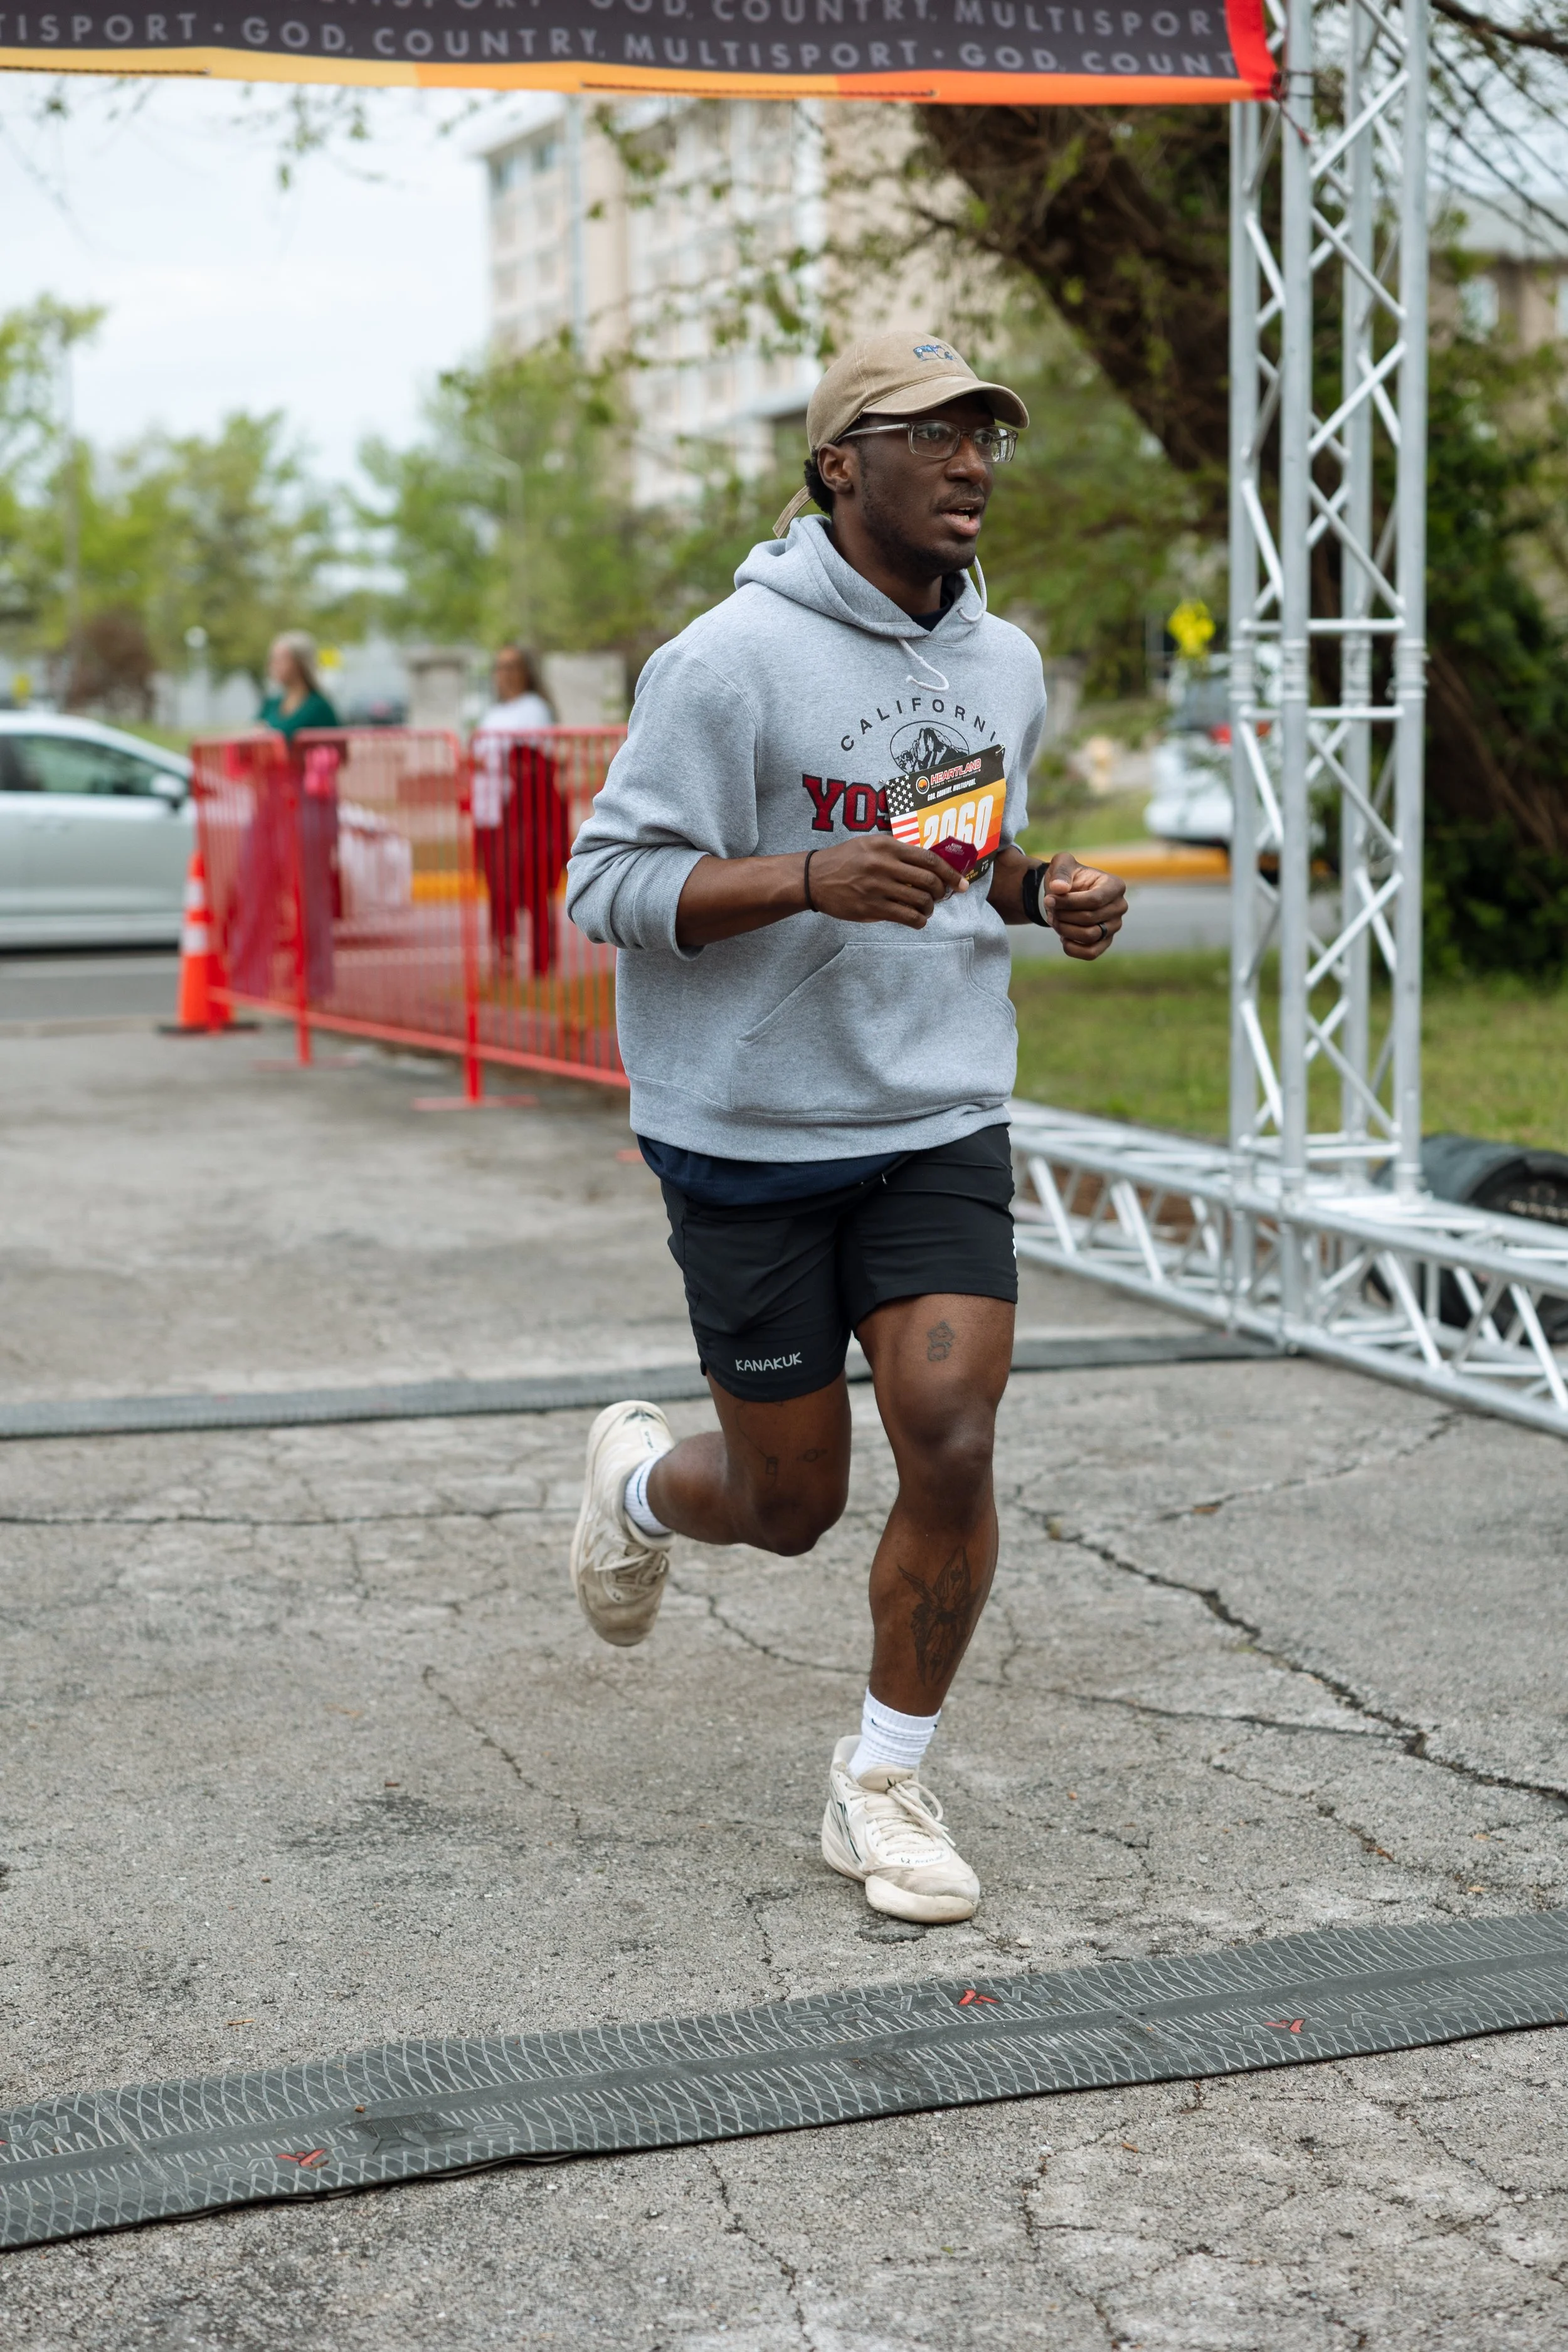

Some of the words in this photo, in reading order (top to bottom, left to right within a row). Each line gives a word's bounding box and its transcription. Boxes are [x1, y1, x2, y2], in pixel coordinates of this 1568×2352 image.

[955, 0, 1226, 38] MULTISPOR
[241, 16, 353, 54] GOD,
[373, 27, 605, 58] COUNTRY,
[624, 32, 918, 68] MULTISPORT
[930, 758, 982, 786] HEARTLAND
[923, 795, 993, 852] 2060
[735, 1352, 802, 1372] KANAKUK
